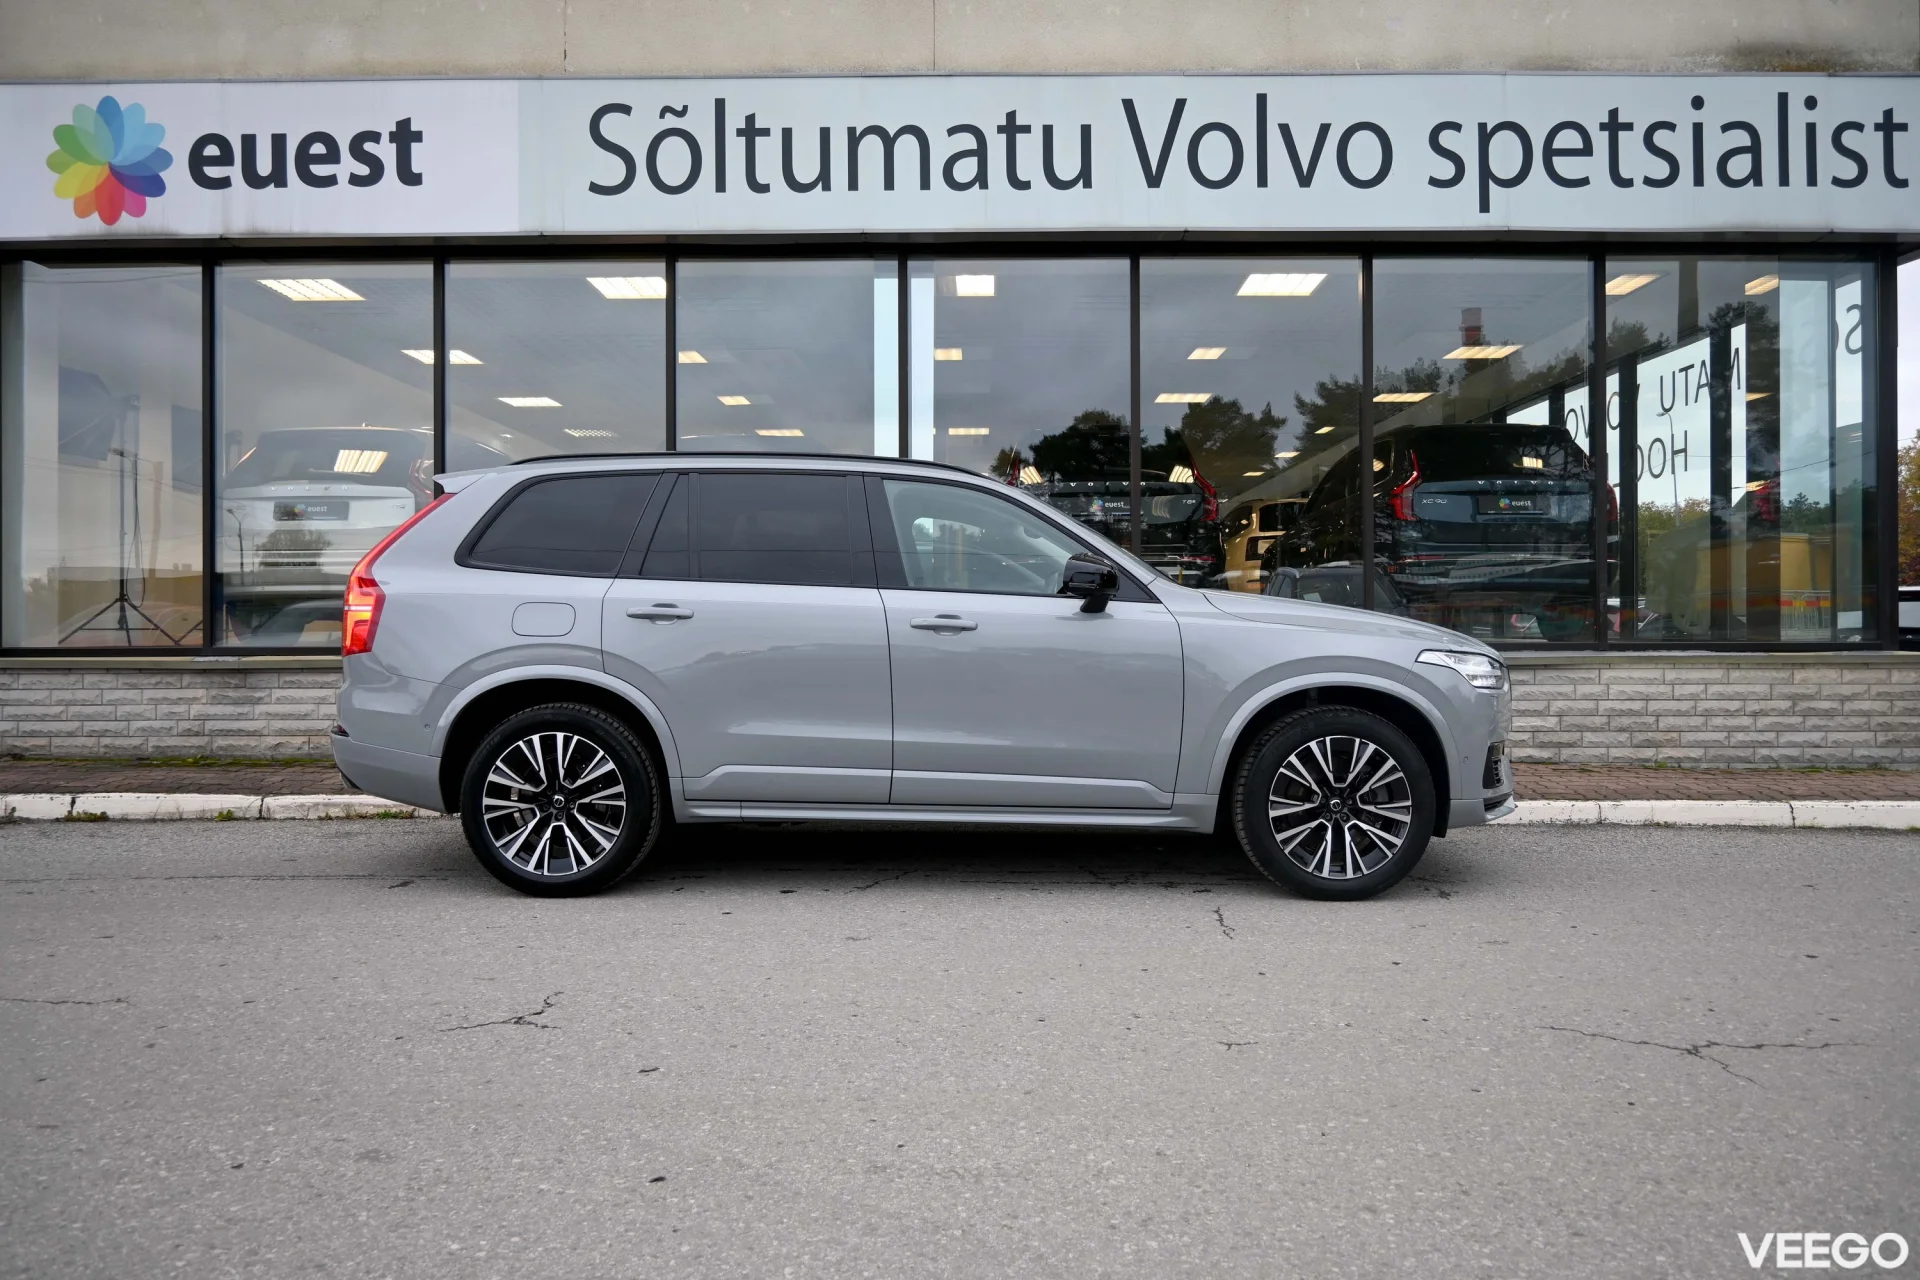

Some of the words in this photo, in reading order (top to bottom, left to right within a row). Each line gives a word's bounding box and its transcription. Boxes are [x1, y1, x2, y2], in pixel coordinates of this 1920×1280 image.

[188, 116, 423, 191] euest
[588, 97, 1093, 196] Sõltumatu
[1121, 92, 1393, 190] Volvo
[1427, 91, 1910, 214] spetsialist
